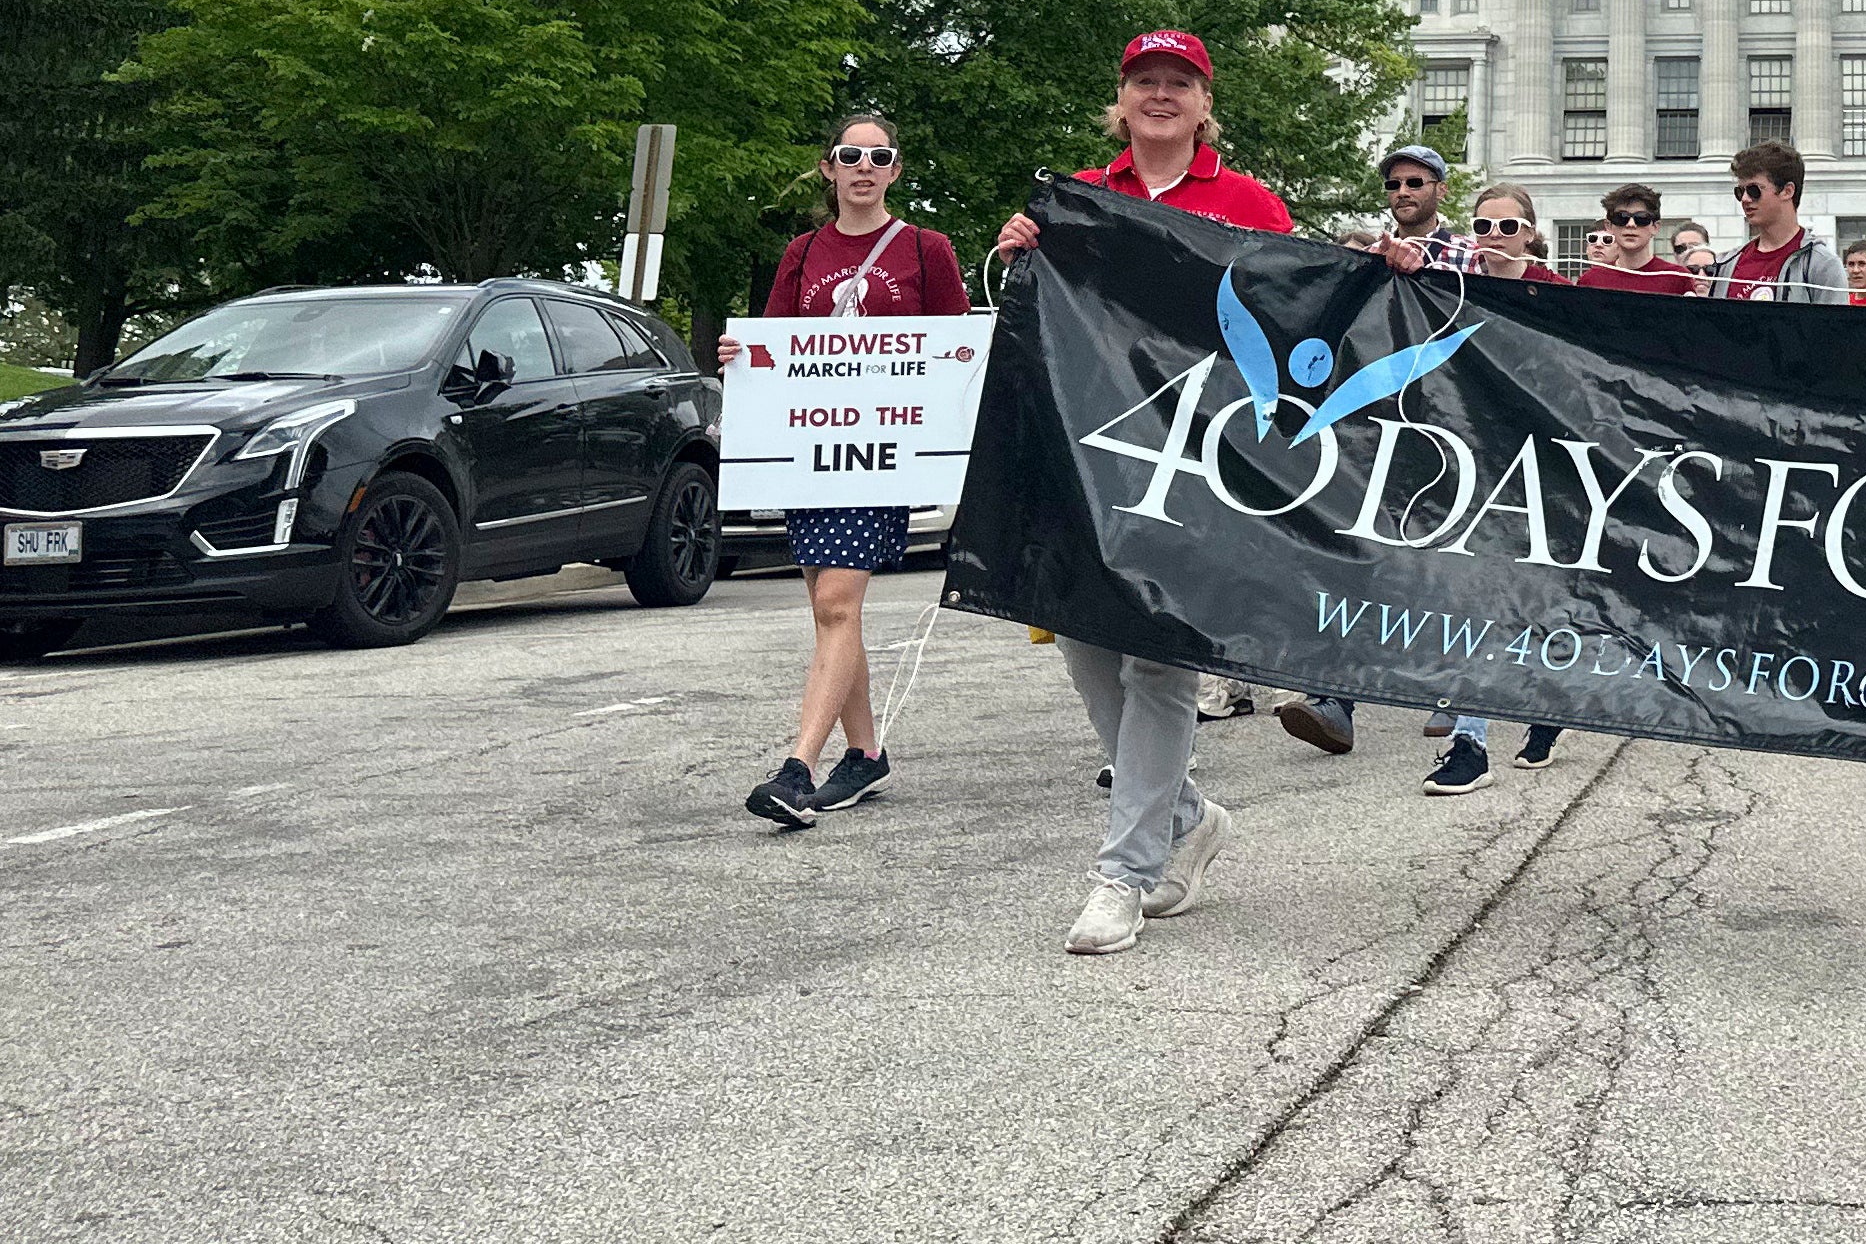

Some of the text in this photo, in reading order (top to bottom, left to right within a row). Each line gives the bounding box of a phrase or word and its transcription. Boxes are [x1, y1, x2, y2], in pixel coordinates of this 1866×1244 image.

[802, 283, 820, 310] 2025
[885, 277, 902, 303] LIFE
[790, 332, 927, 356] MIDWEST
[787, 361, 926, 378] MARCH FOR LIFE
[789, 406, 924, 428] HOLD THE
[813, 442, 898, 473] LINE
[1078, 351, 1340, 527] 40
[1334, 415, 1724, 583] DAYS
[18, 532, 68, 553] SHU FRK
